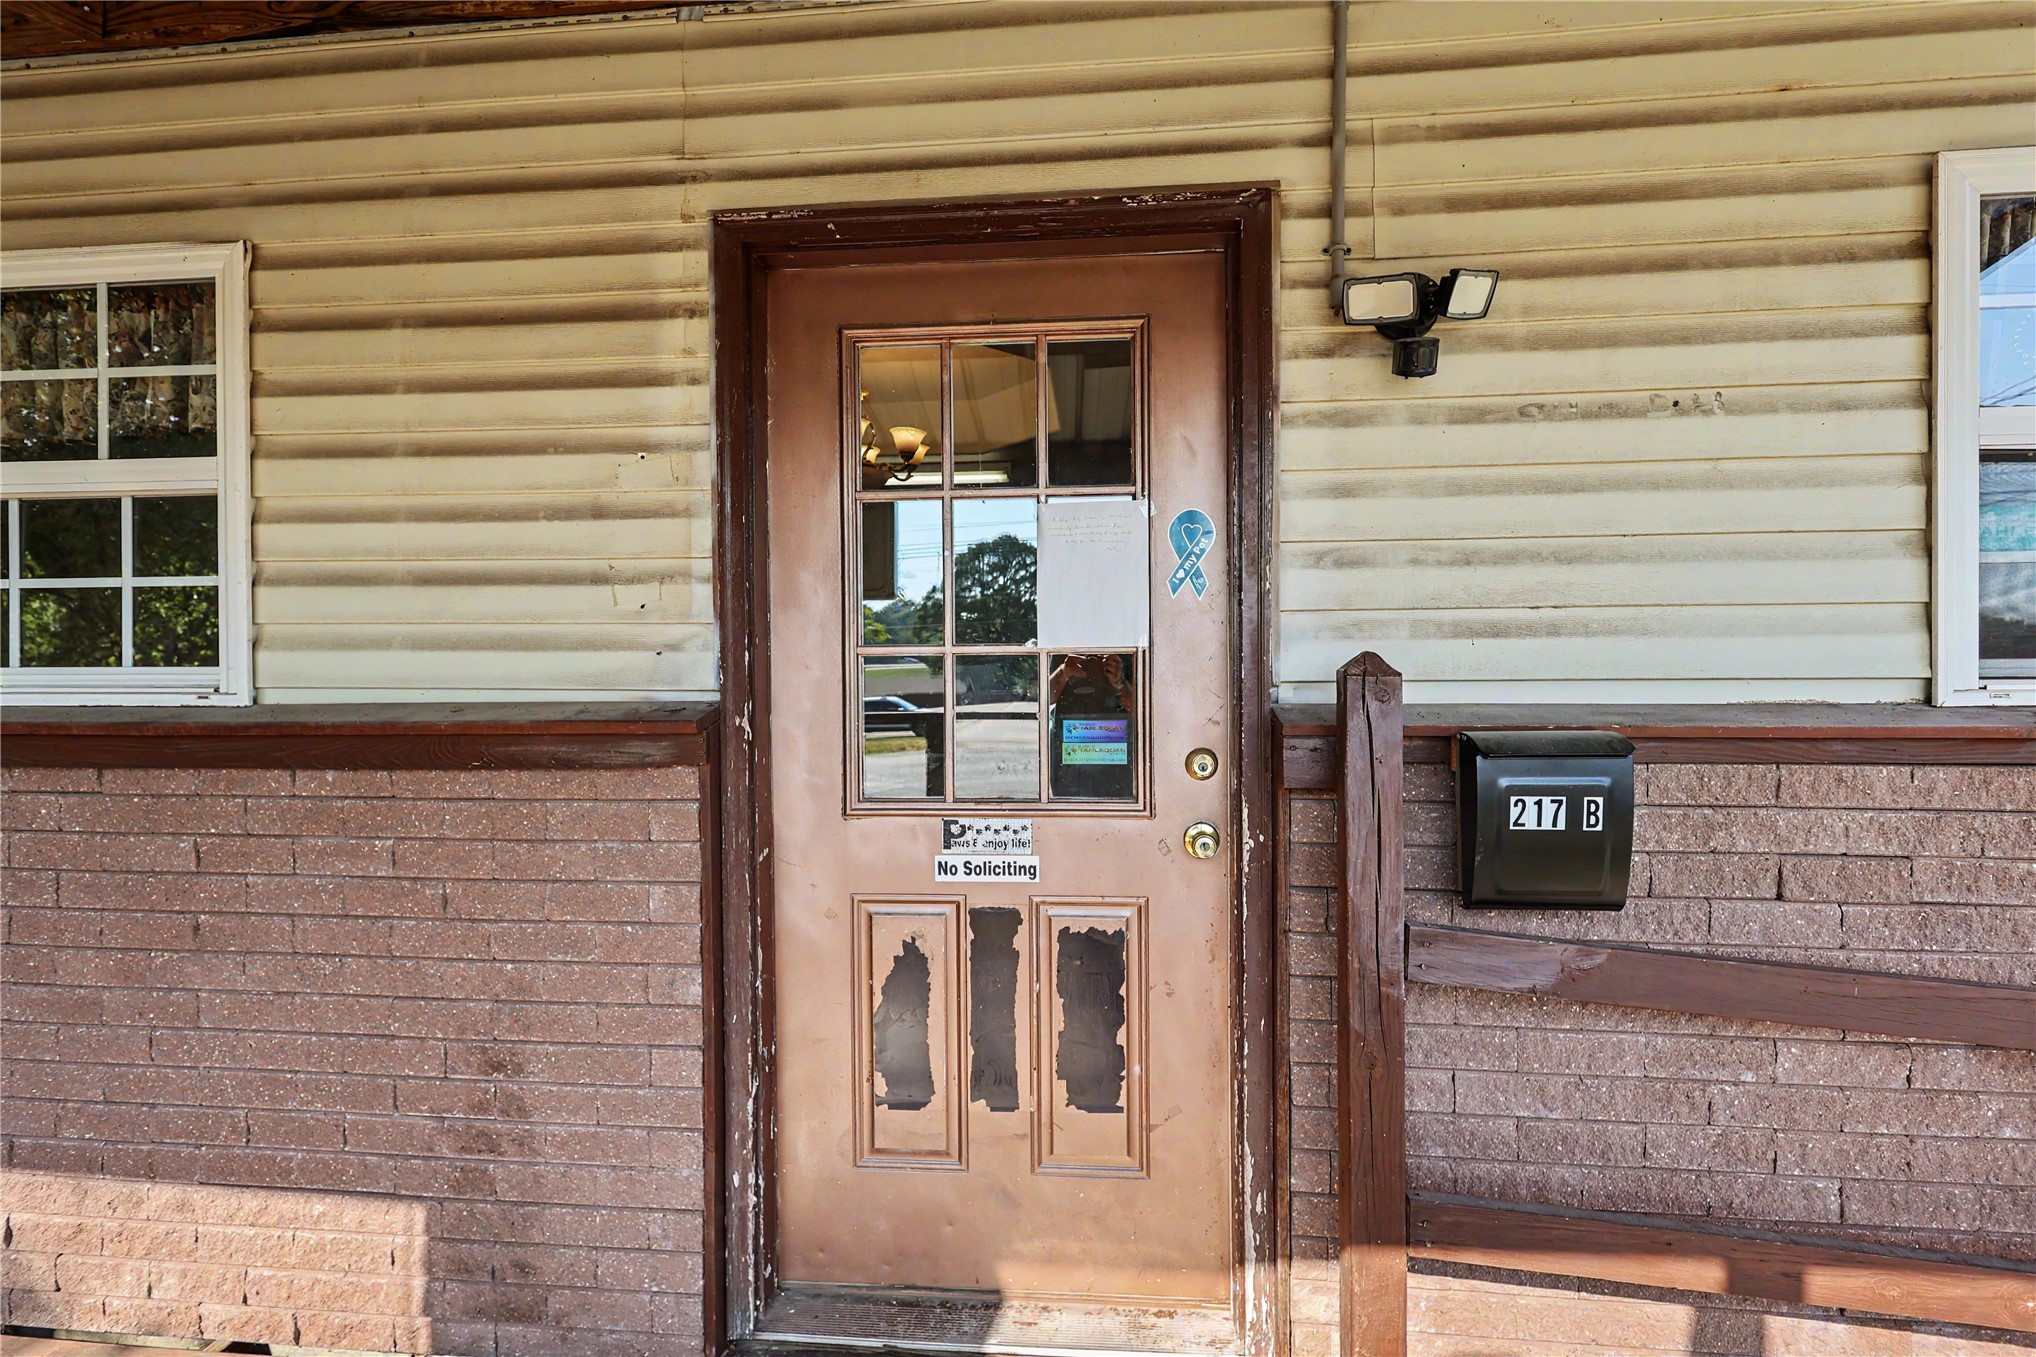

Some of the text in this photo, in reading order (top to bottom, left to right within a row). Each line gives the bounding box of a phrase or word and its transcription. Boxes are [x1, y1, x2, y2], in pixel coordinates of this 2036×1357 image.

[1184, 554, 1197, 570] my
[1193, 537, 1209, 554] Pet
[1512, 798, 1600, 829] 217 B
[982, 838, 1008, 851] enjoy
[1012, 838, 1031, 848] life!
[937, 860, 1037, 880] No Soliciting
